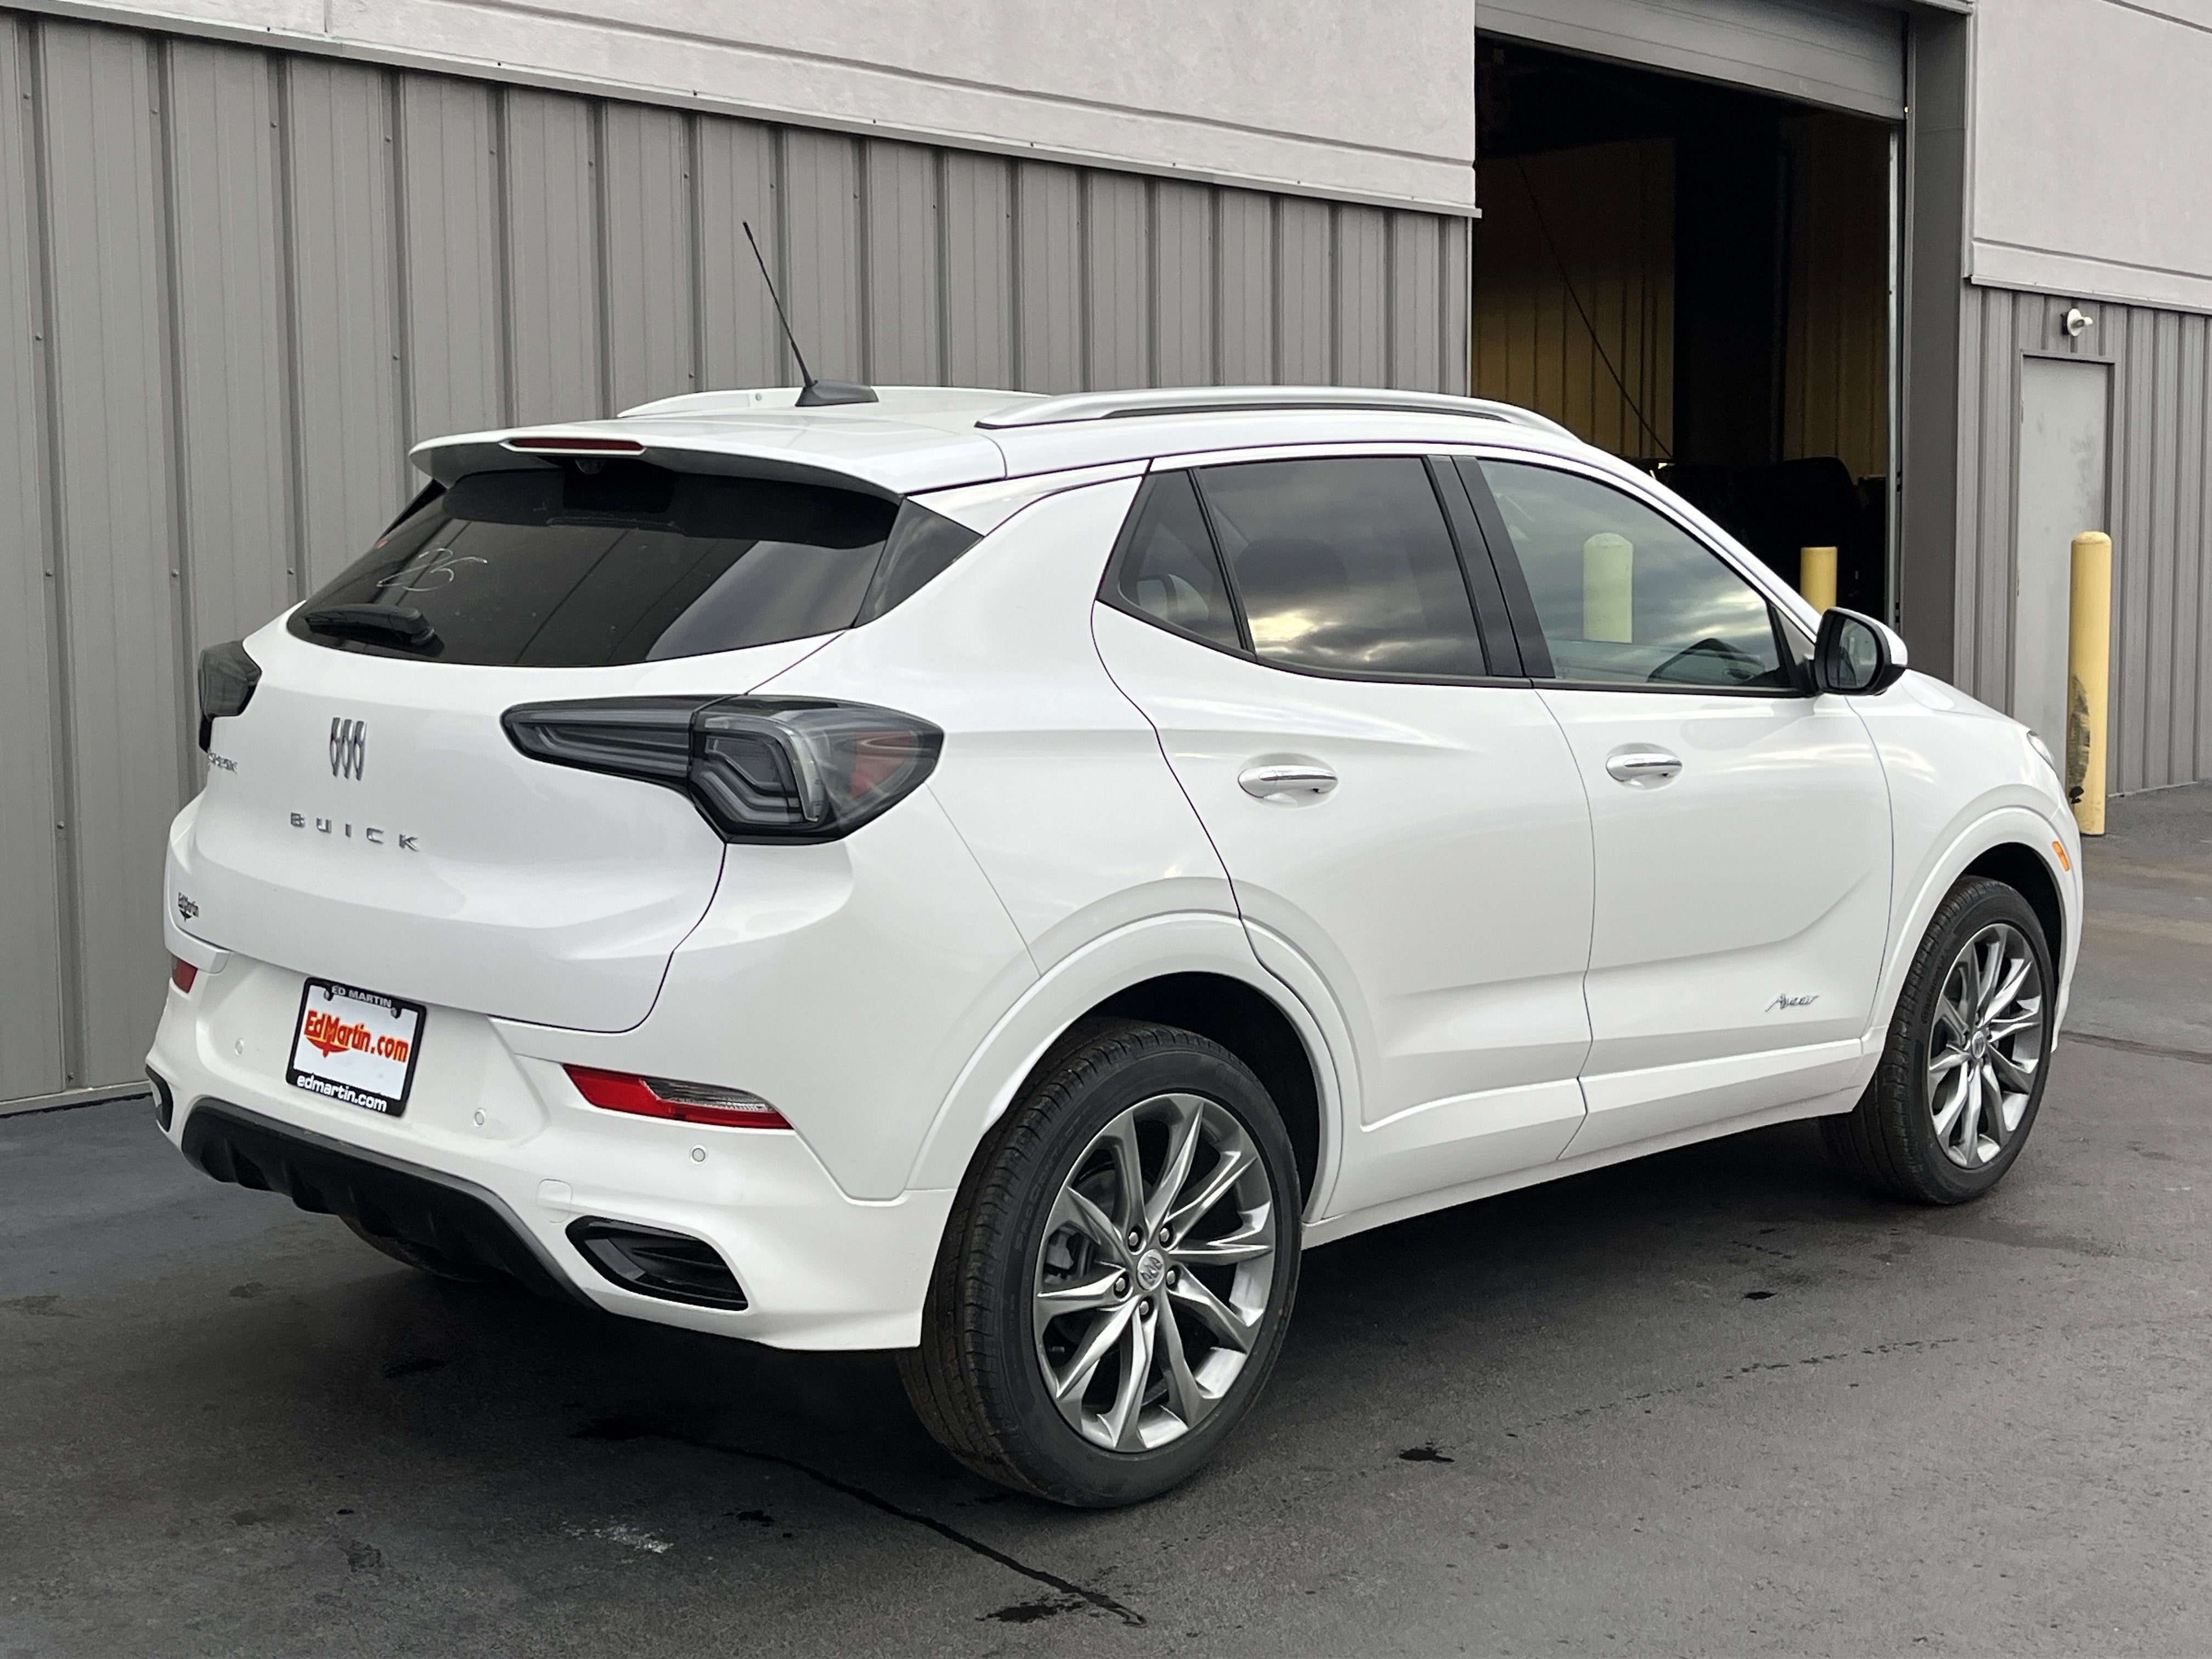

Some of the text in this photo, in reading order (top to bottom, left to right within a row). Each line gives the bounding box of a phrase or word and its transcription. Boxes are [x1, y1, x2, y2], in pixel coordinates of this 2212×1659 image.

[290, 811, 420, 851] BUICK
[331, 985, 393, 1008] ED MARTIN
[303, 1009, 410, 1063] EdMartin.com
[296, 1072, 387, 1113] edmartin.com
